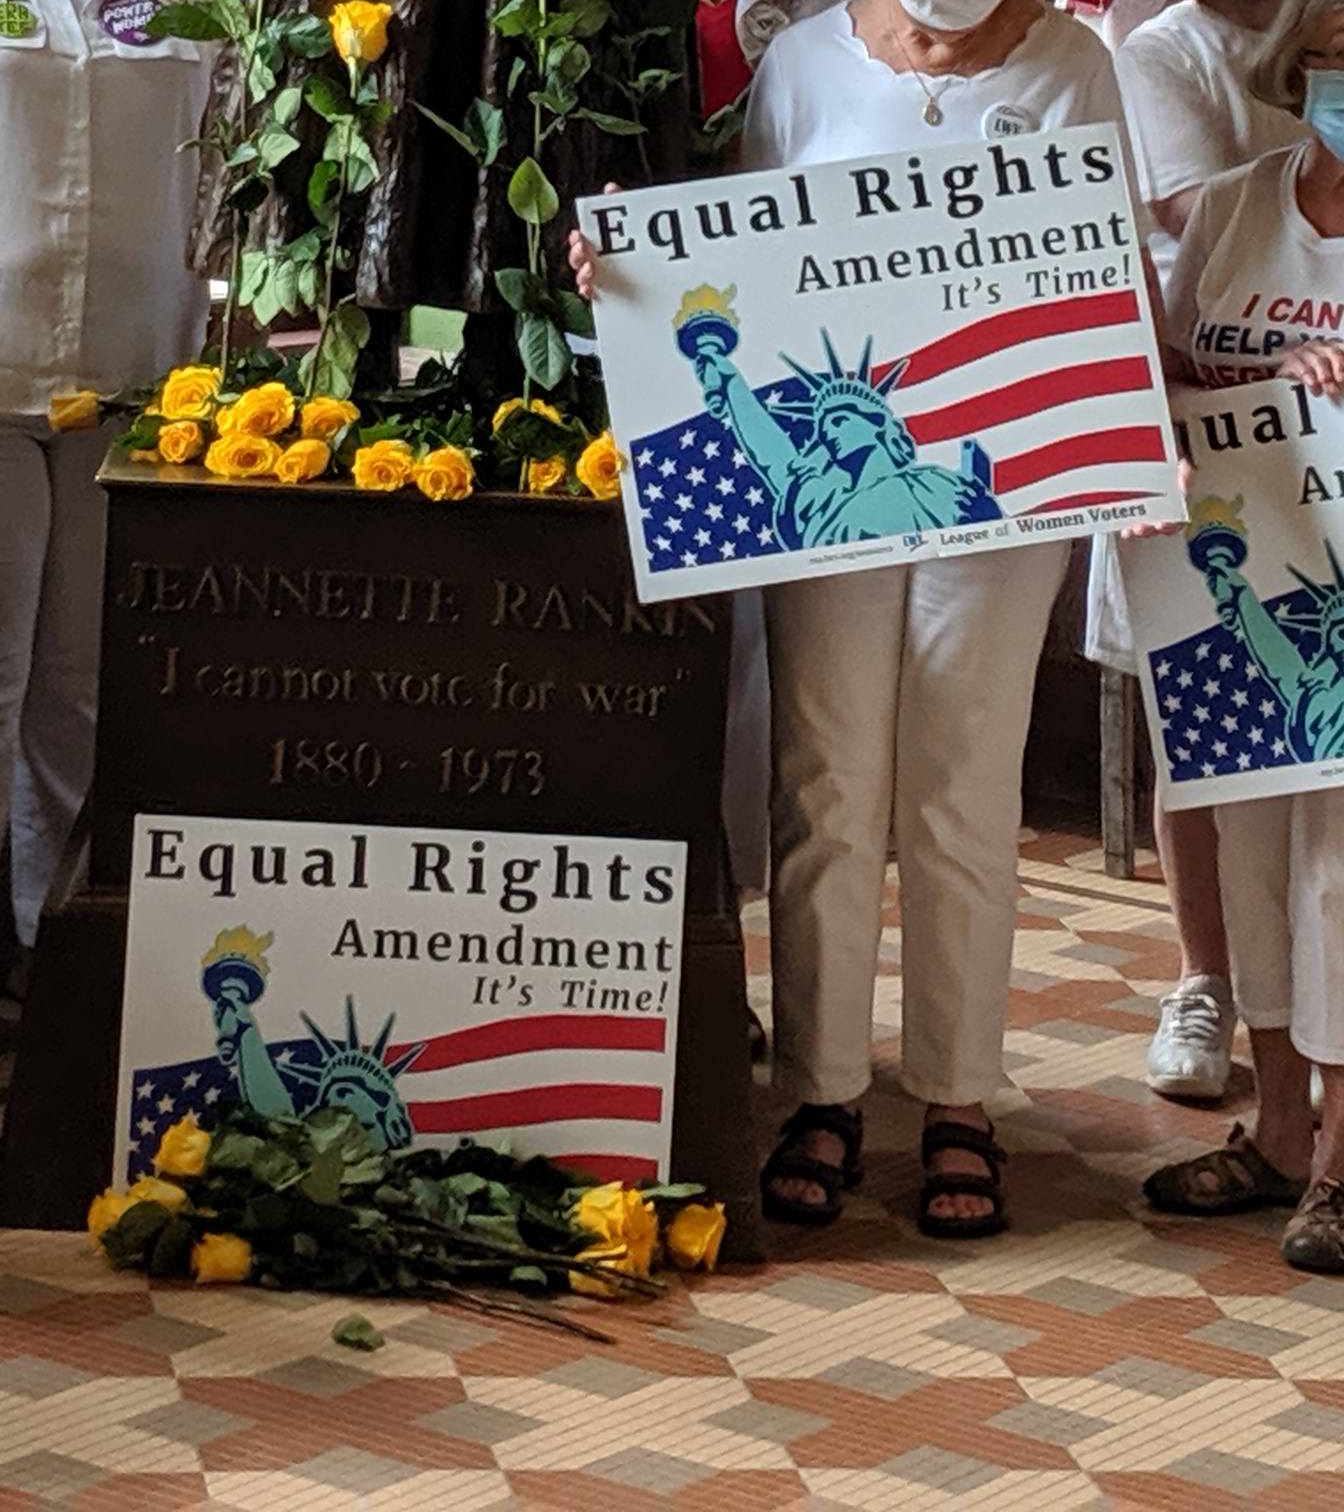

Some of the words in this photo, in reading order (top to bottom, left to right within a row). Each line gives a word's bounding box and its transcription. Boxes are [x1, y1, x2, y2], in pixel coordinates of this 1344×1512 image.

[590, 174, 818, 261] Equal
[850, 143, 1117, 219] Rights
[795, 211, 1132, 294] Amendment
[942, 281, 1003, 312] It's
[1026, 255, 1133, 301] Time!
[1241, 292, 1261, 319] I
[1266, 296, 1344, 331] CAN
[1194, 321, 1286, 357] HELP
[1173, 383, 1318, 471] ual
[939, 528, 990, 548] League
[1016, 510, 1085, 535] Women
[1087, 502, 1148, 525] Voters
[120, 562, 460, 623] JEANNETTE
[196, 666, 356, 703] cannot
[370, 670, 474, 708] vote
[489, 661, 558, 713] for
[267, 737, 384, 788] 1880
[439, 745, 547, 798] 1973
[143, 828, 368, 898] Equal
[407, 840, 675, 913] Rights
[331, 918, 674, 973] Amendment
[472, 975, 534, 1006] It's
[559, 978, 670, 1012] Time!
